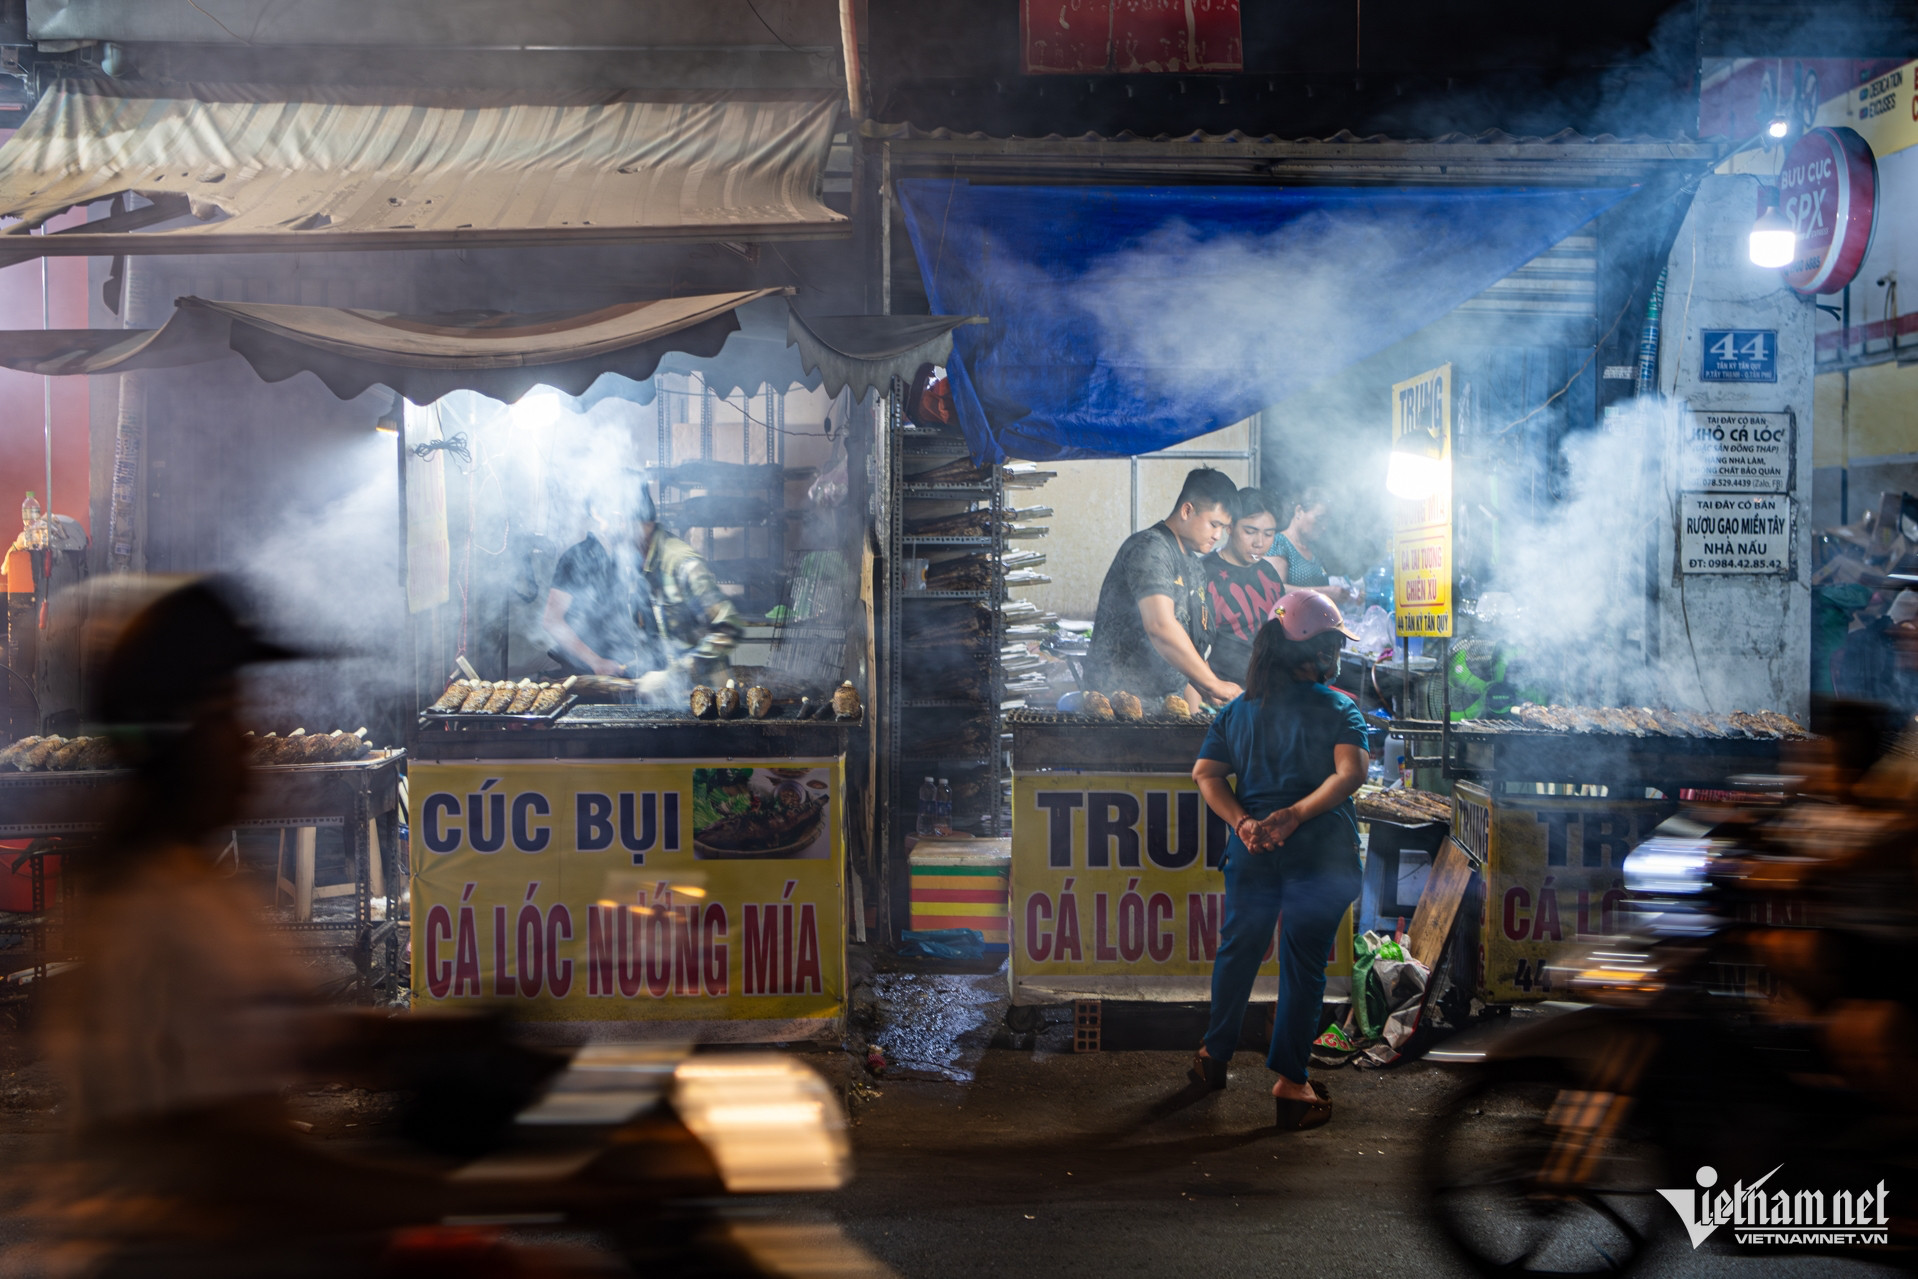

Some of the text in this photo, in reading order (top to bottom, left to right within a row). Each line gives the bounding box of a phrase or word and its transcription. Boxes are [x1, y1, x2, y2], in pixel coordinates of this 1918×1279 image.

[1781, 158, 1832, 190] BƯU CỤC
[1785, 188, 1827, 240] SPX
[1709, 333, 1769, 361] 44
[1692, 425, 1782, 442] KHÔ CÁ LÓC
[1720, 416, 1736, 424] ĐÂY
[1750, 416, 1766, 425] BÁN
[1718, 466, 1739, 475] CHẤT
[1740, 466, 1757, 475] BẢO
[1728, 456, 1746, 464] NHÀ
[1747, 456, 1766, 466] LÀM,
[1697, 500, 1776, 511] TẠI ĐÂY CÓ BÁN
[1687, 513, 1785, 539] RƯỢU GẠO MIỀN TÂY
[1704, 539, 1767, 555] NHÀ NẤU
[1689, 559, 1782, 569] ĐT: 0984.42.85.42
[1406, 575, 1426, 601] CHIÊN
[1405, 612, 1416, 631] TÂN
[1424, 612, 1435, 631] TÂN
[422, 777, 681, 866] CÚC BỤI
[1026, 877, 1083, 963] CÁ
[1095, 877, 1174, 963] LÓC
[1503, 876, 1562, 942] CÁ
[425, 879, 823, 999] CÁ LÓC NƯỚNG MÍA
